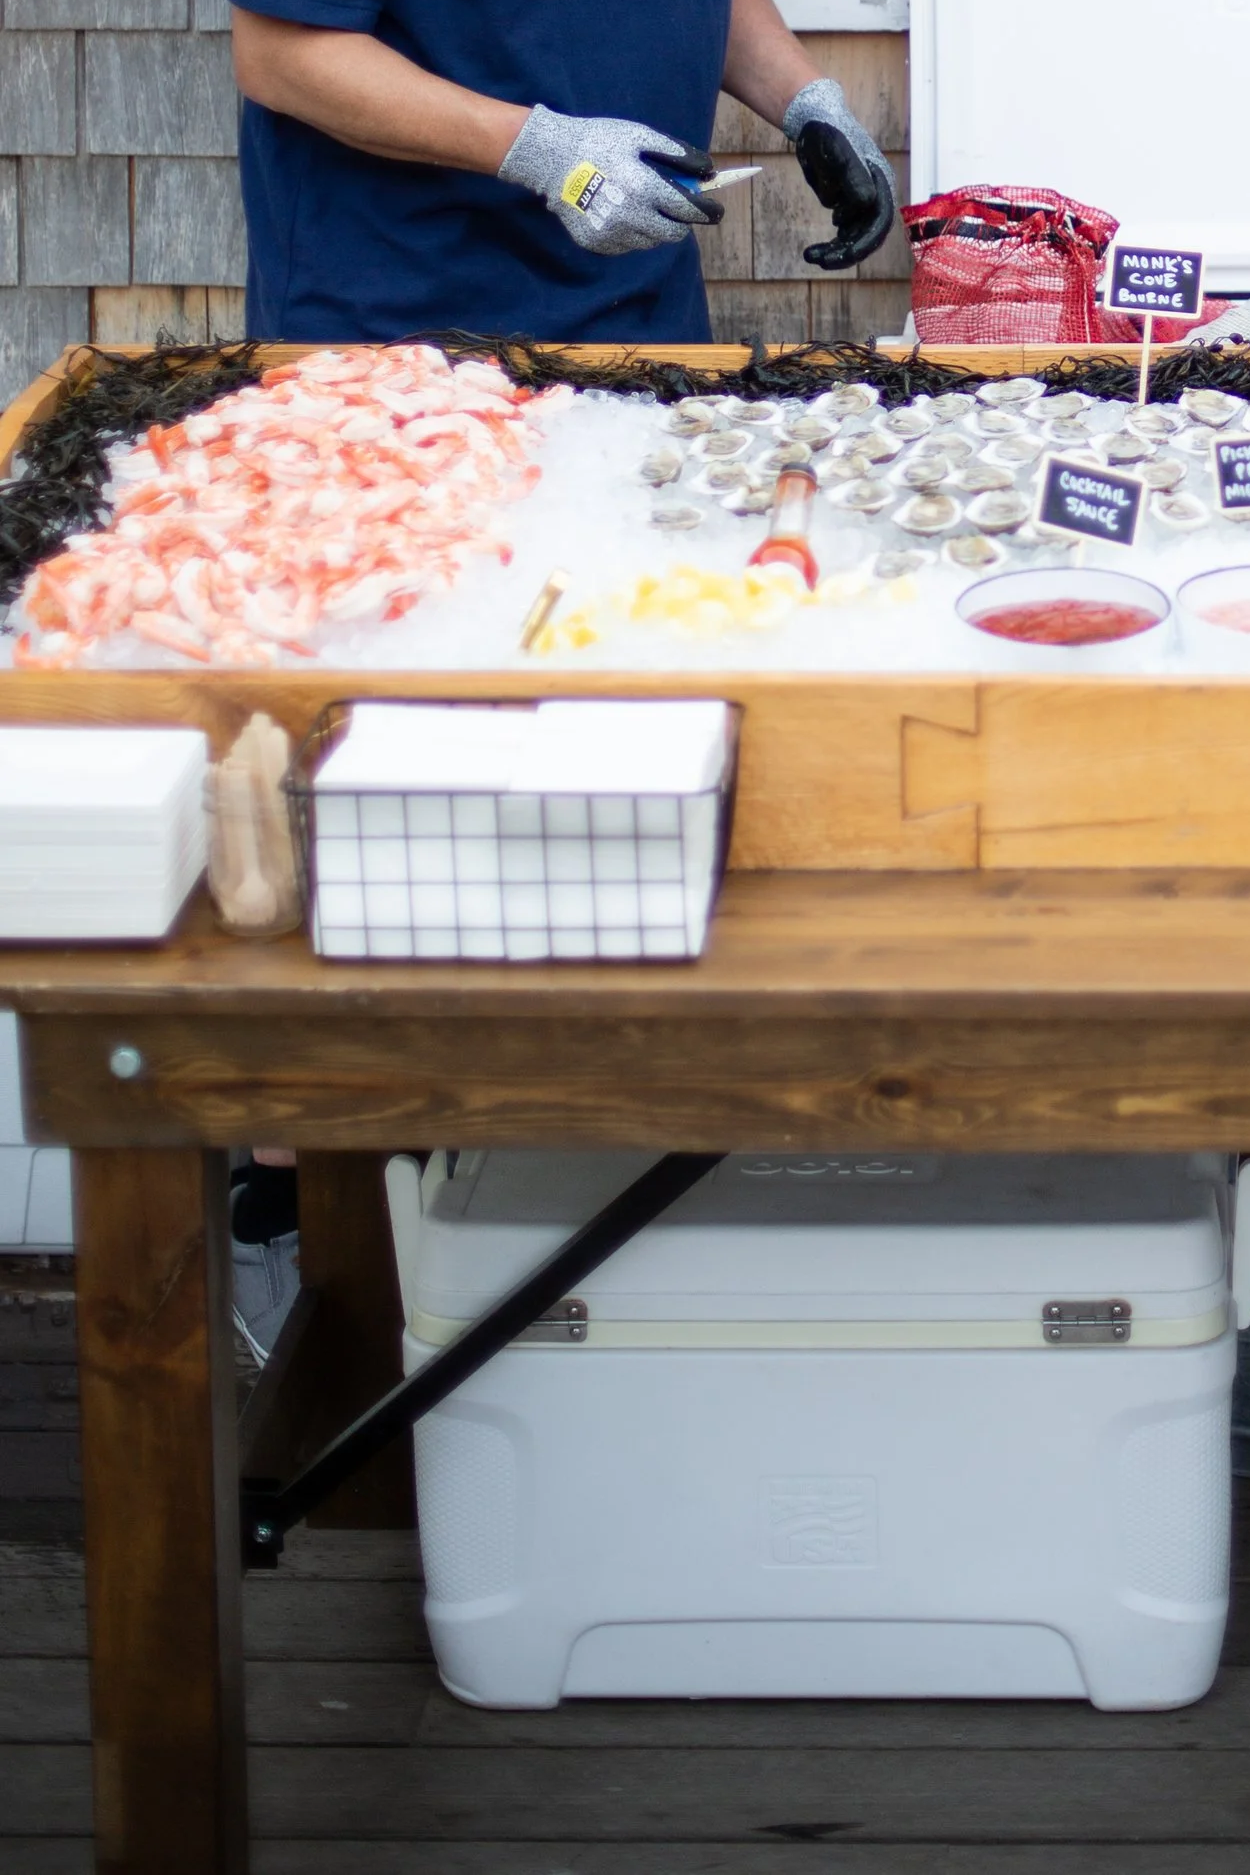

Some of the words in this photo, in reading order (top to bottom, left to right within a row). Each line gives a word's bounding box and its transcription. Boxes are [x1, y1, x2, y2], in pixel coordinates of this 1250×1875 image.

[587, 172, 604, 194] DEX
[580, 190, 592, 208] FIT
[1122, 254, 1193, 274] MONK'S
[1129, 272, 1178, 288] COVE
[1118, 287, 1184, 308] BOURNE
[1059, 470, 1132, 506] COCKTAIL
[1065, 496, 1120, 531] SAUCE
